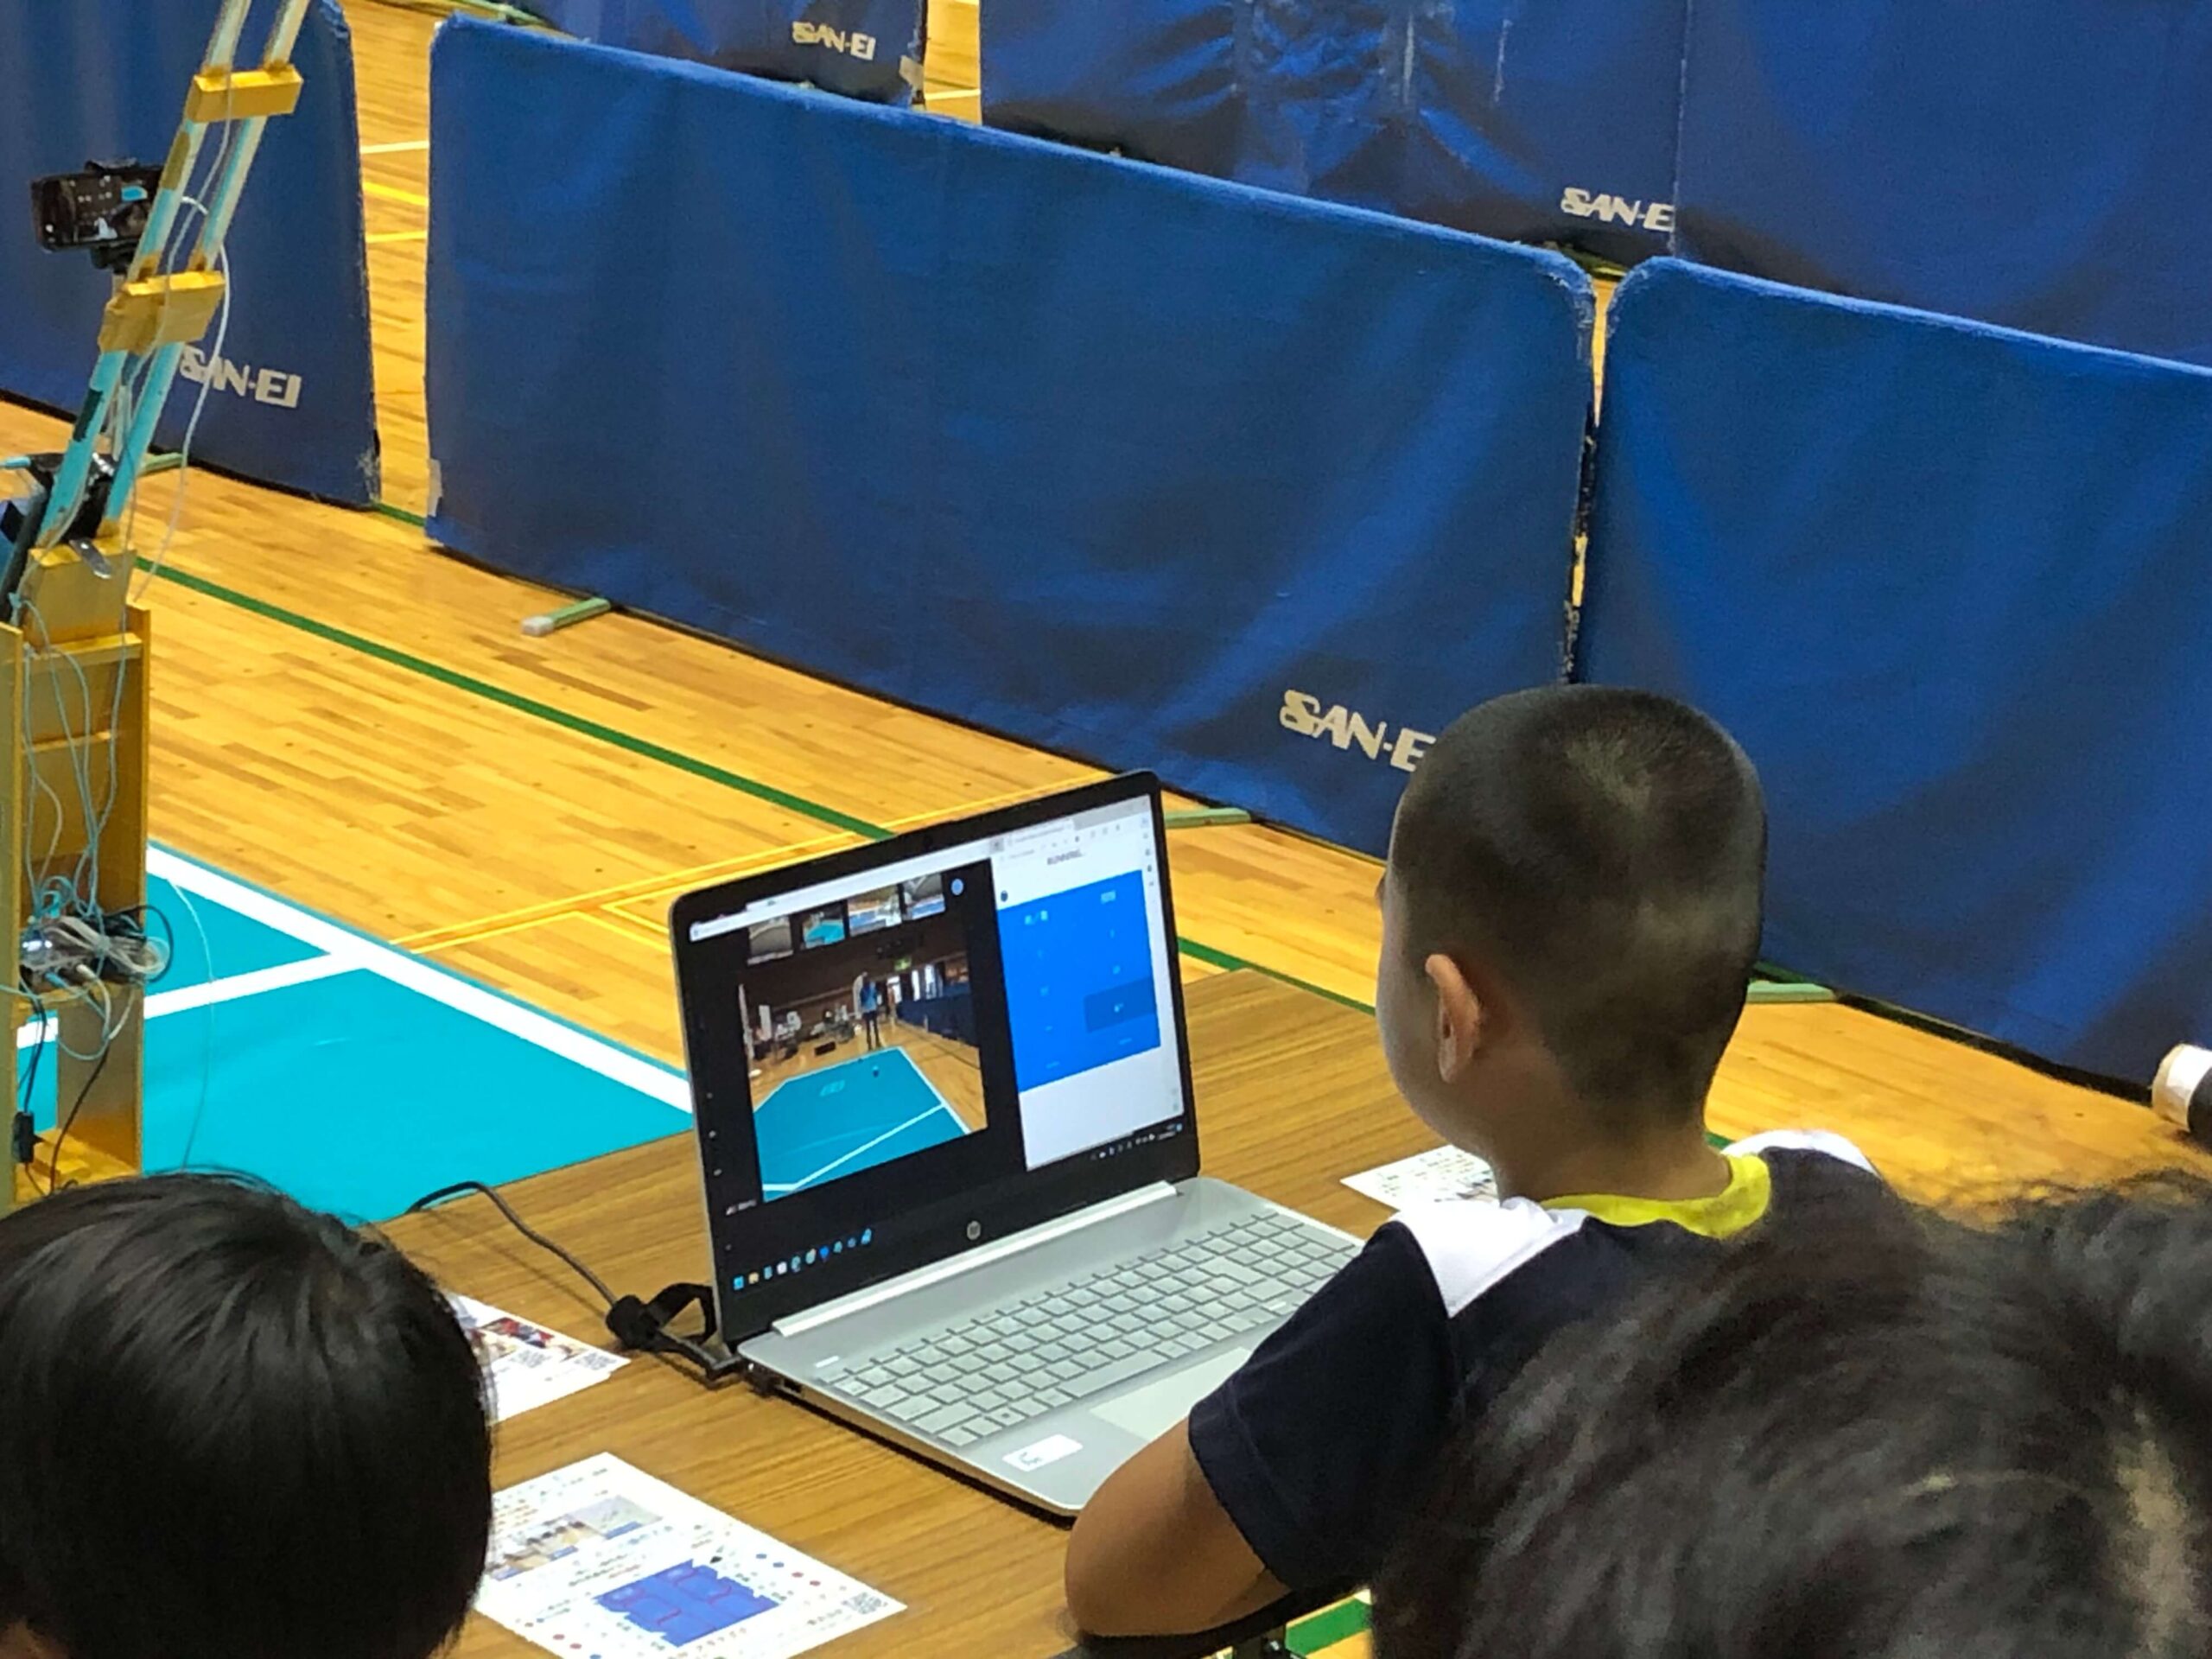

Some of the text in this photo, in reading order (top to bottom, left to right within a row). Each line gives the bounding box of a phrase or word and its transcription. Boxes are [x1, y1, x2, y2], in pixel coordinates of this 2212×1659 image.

[792, 21, 876, 60] SAN-EI
[1560, 187, 1675, 232] SAN-E
[180, 345, 302, 408] SAN-EI
[1280, 690, 1437, 772] SAN-E
